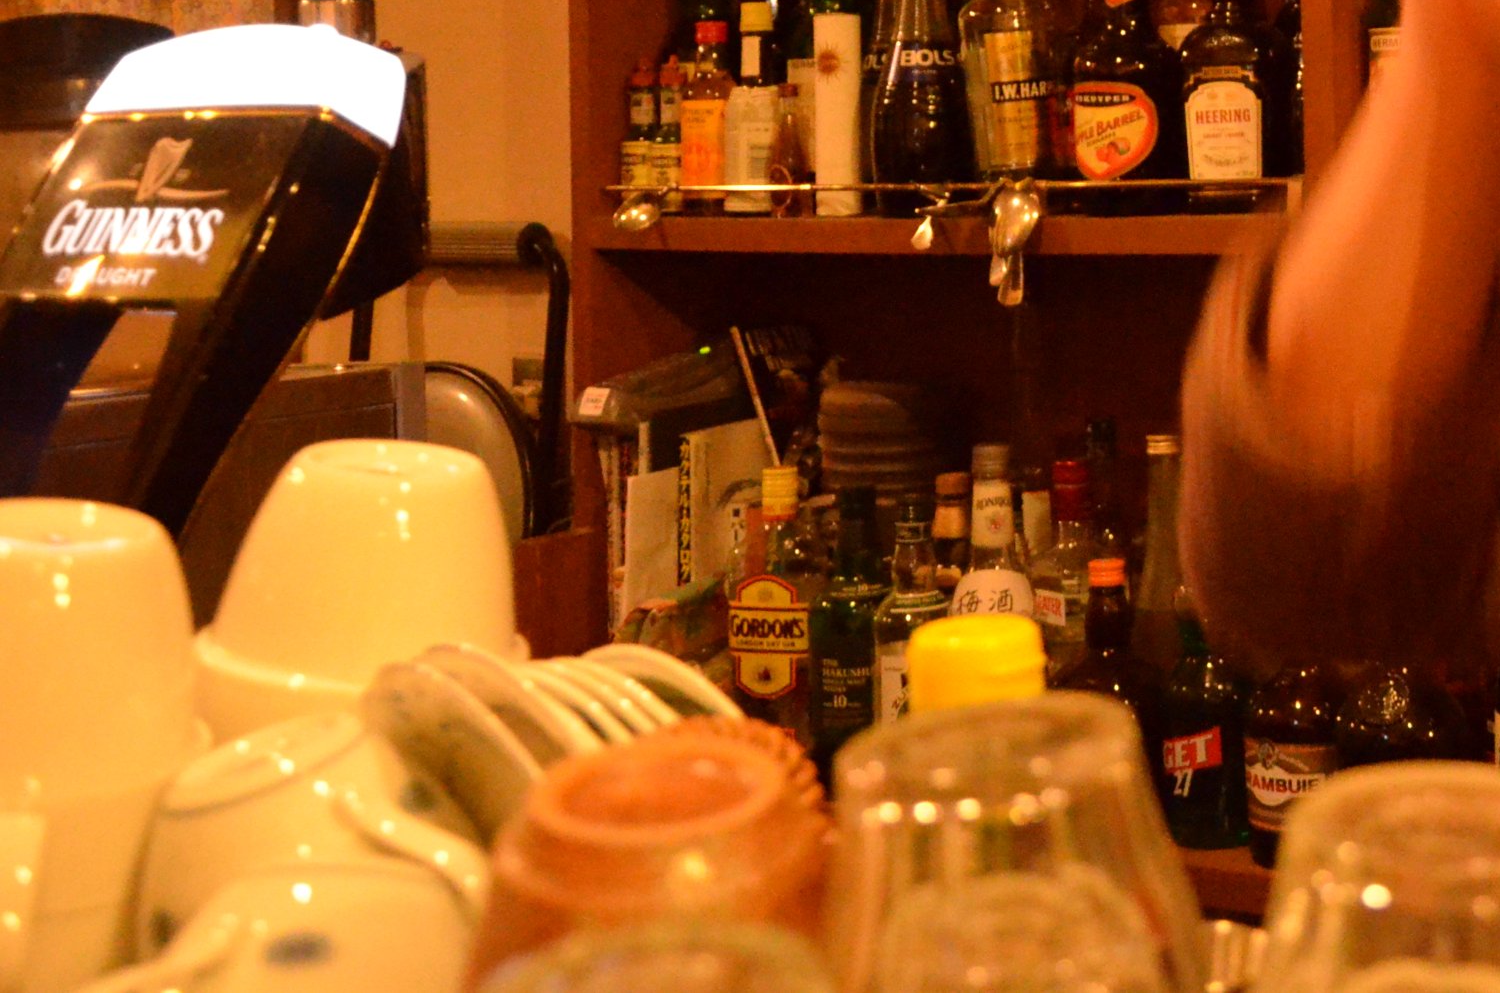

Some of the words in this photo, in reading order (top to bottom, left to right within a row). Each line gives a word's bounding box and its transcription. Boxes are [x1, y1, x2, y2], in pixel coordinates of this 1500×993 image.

[899, 48, 955, 68] BOLS
[1195, 108, 1252, 125] HEERING
[42, 198, 225, 258] GUINNESS
[957, 587, 1014, 614] 梅酒
[730, 614, 805, 639] GORDON'S
[832, 693, 849, 709] 10
[1162, 733, 1213, 769] GET
[1173, 768, 1194, 798] 27
[1249, 774, 1320, 795] AMBUIE
